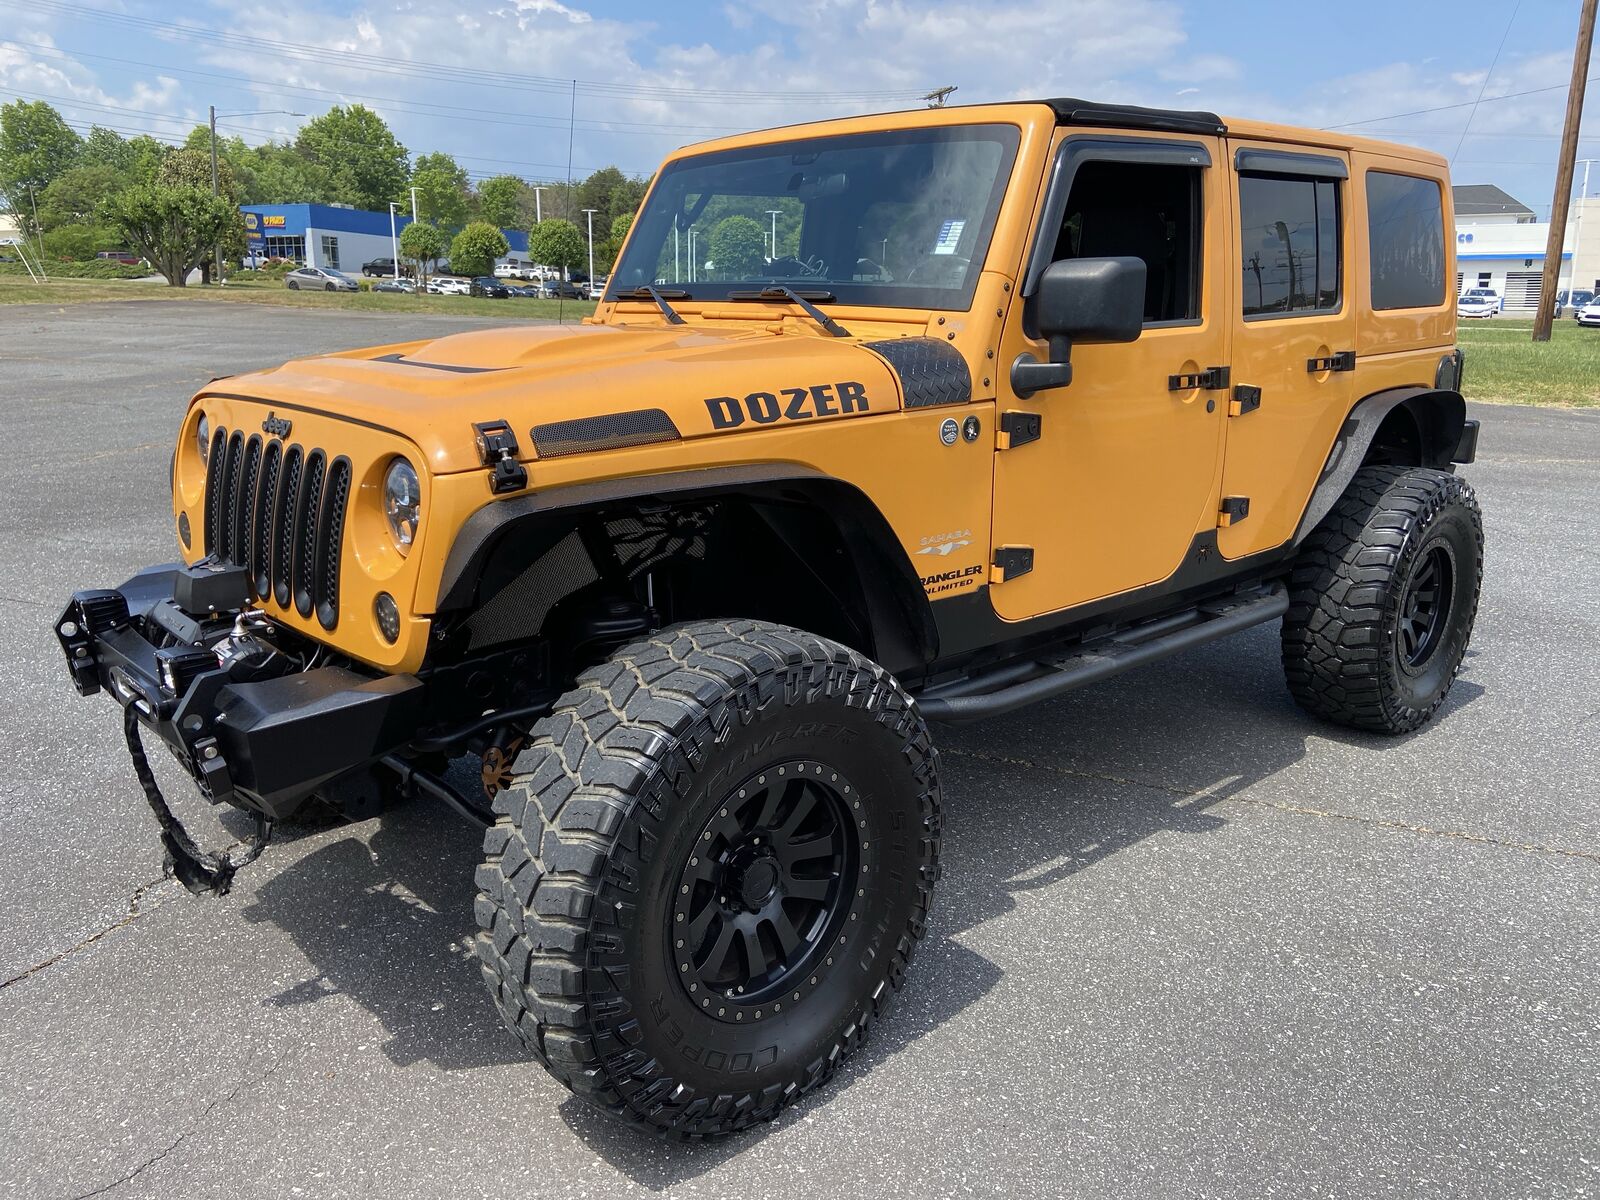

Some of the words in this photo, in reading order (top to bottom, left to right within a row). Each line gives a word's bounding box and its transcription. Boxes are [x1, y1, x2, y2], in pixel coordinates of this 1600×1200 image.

[704, 381, 869, 430] DOZER
[262, 411, 292, 441] Jeep
[920, 528, 972, 546] SAHARA
[919, 564, 983, 586] RANGLER
[925, 579, 973, 594] NLIMITED
[650, 991, 777, 1073] COOPER
